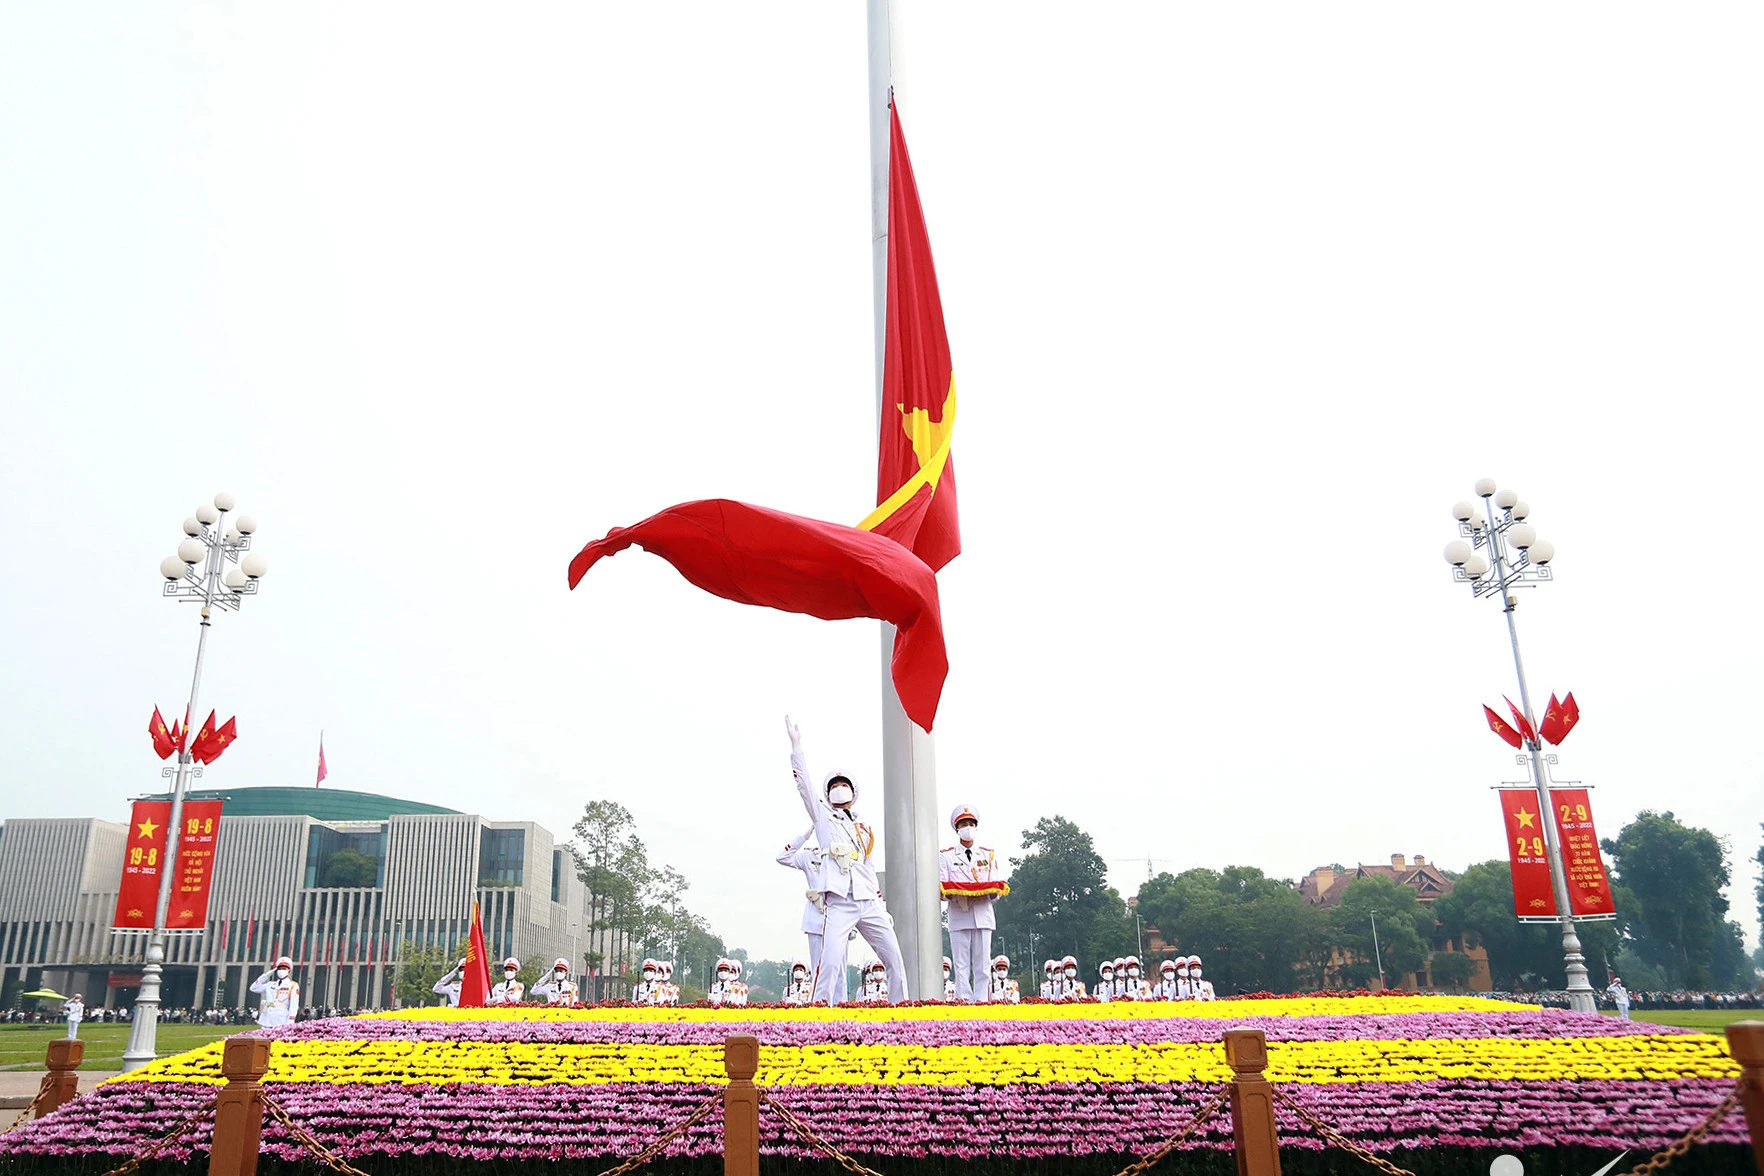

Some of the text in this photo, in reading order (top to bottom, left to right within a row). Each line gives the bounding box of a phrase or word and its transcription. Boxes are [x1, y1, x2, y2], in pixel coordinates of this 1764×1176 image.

[1560, 804, 1587, 822] 2-9
[187, 818, 213, 834] 19-8
[1516, 837, 1544, 856] 2-9
[130, 847, 157, 866] 19-8
